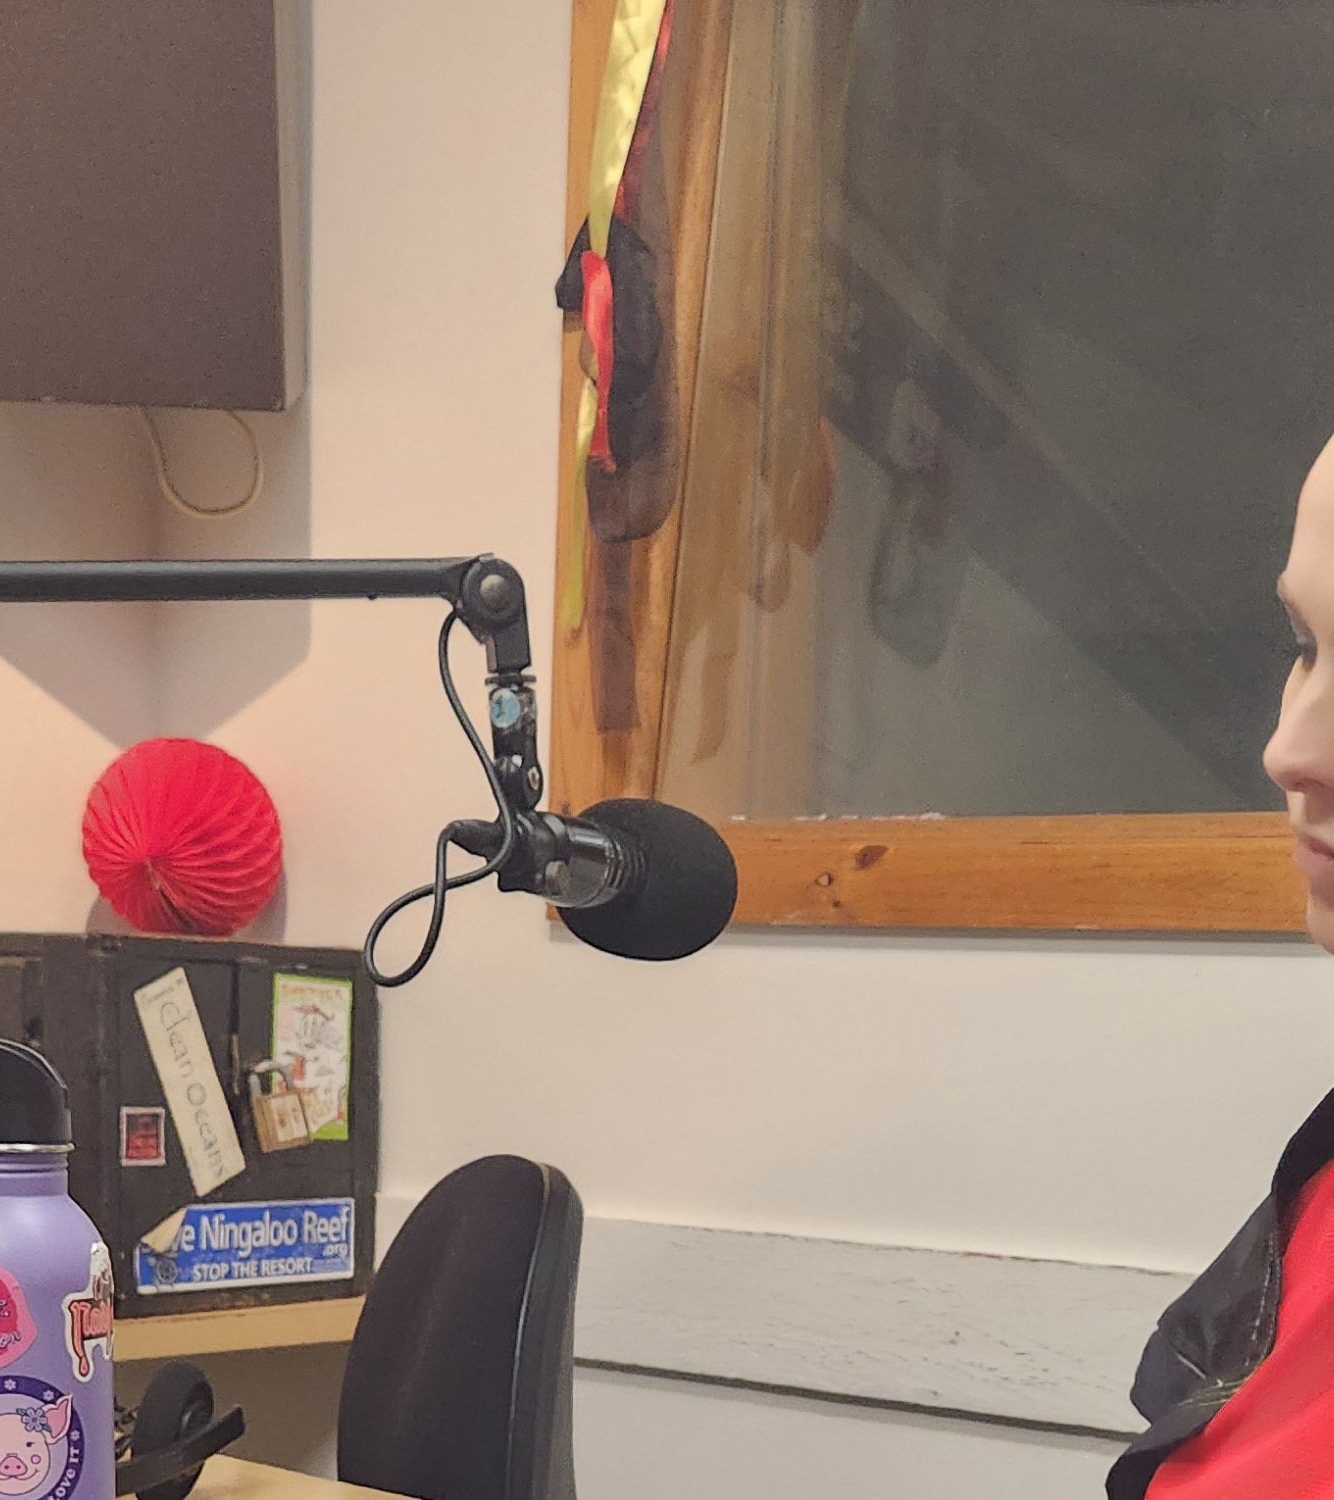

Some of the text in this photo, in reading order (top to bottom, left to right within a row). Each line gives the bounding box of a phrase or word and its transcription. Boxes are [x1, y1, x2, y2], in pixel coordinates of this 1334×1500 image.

[200, 1211, 298, 1258] Ningaloo
[303, 1206, 350, 1245] Reef
[193, 1257, 313, 1282] STOP THE RESORT
[69, 1446, 80, 1464] IT
